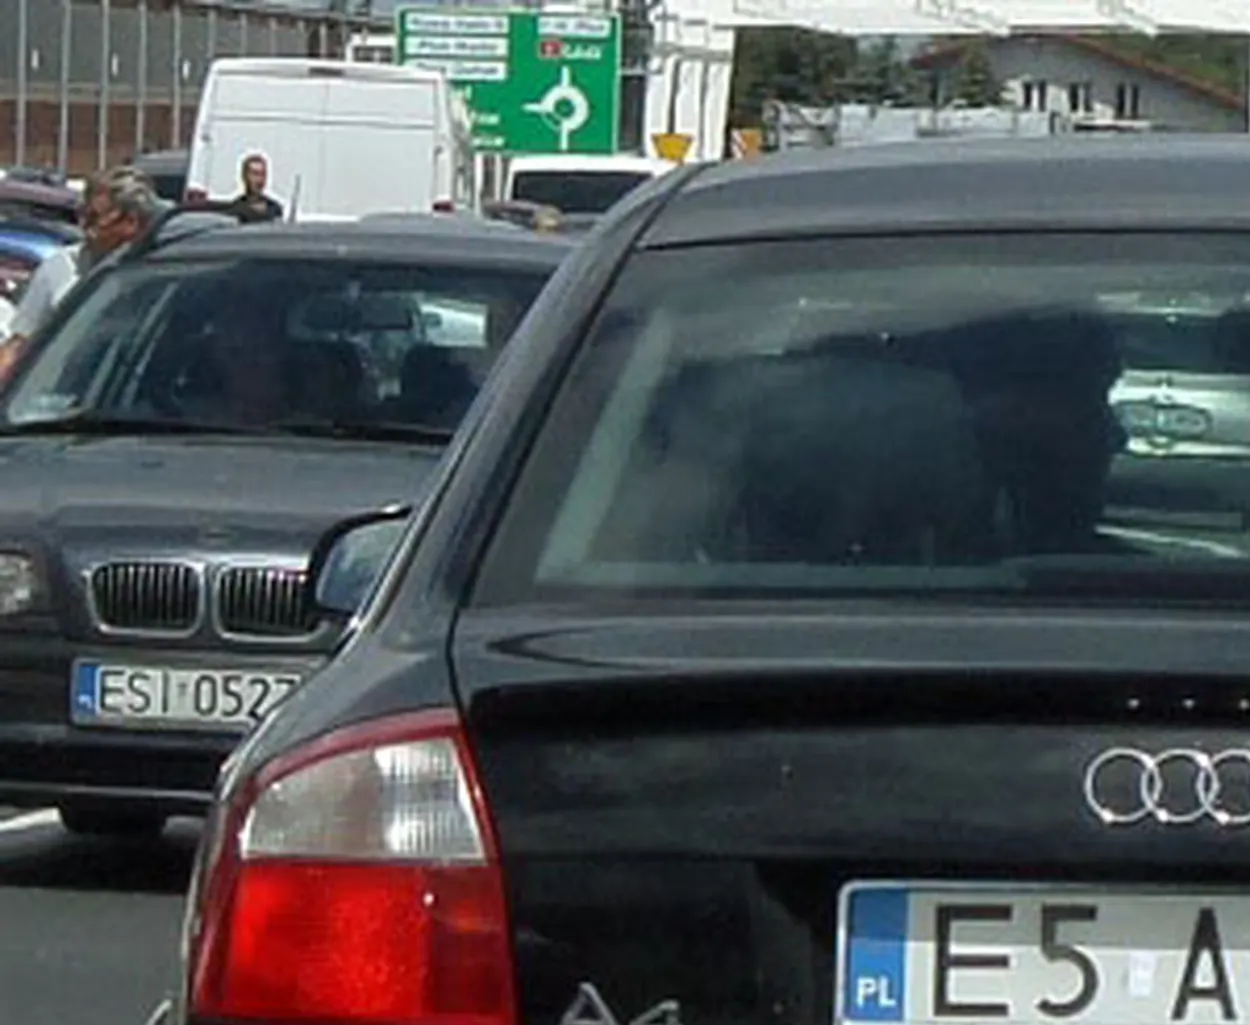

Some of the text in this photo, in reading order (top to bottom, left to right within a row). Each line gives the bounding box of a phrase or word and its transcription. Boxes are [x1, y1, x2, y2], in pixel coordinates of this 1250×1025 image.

[100, 670, 170, 714] ESI
[933, 903, 1099, 1019] E5
[856, 976, 897, 1008] PL
